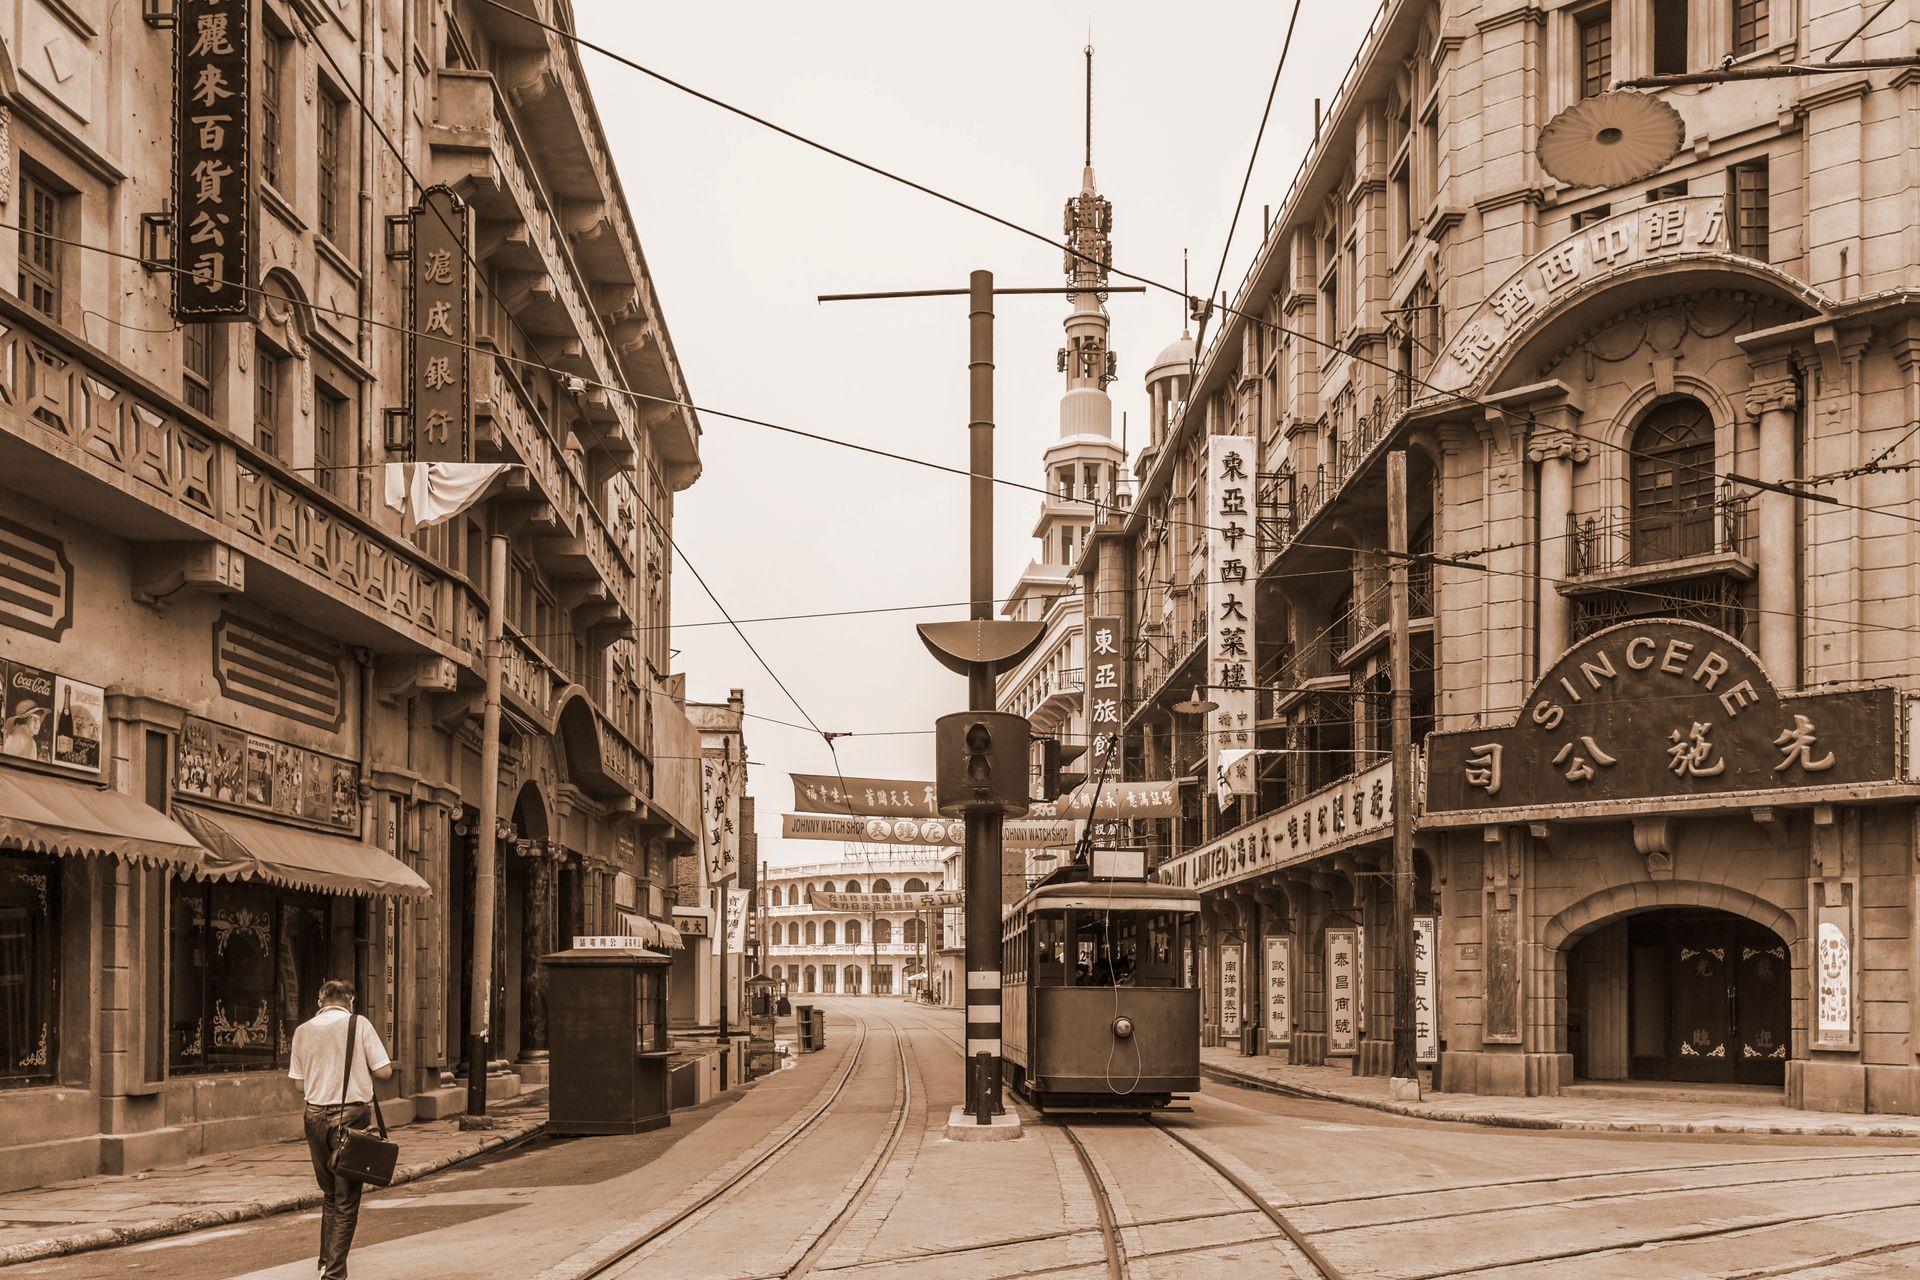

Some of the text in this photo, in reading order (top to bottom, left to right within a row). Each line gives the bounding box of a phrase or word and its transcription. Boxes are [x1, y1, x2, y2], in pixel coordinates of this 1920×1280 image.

[188, 0, 236, 293] 麗來百貨公司
[424, 249, 456, 444] 滬成銀行
[1219, 450, 1248, 693] 東亞中西大菜樓
[13, 672, 51, 696] Coca-Cola
[1531, 636, 1759, 731] SINCERE
[1465, 714, 1835, 796] 先施公司
[791, 819, 865, 836] JOHNNY WATCH SHOP
[1028, 827, 1052, 842] WATCH
[1051, 828, 1069, 842] SHOP
[1334, 952, 1351, 1034] 泰昌商號
